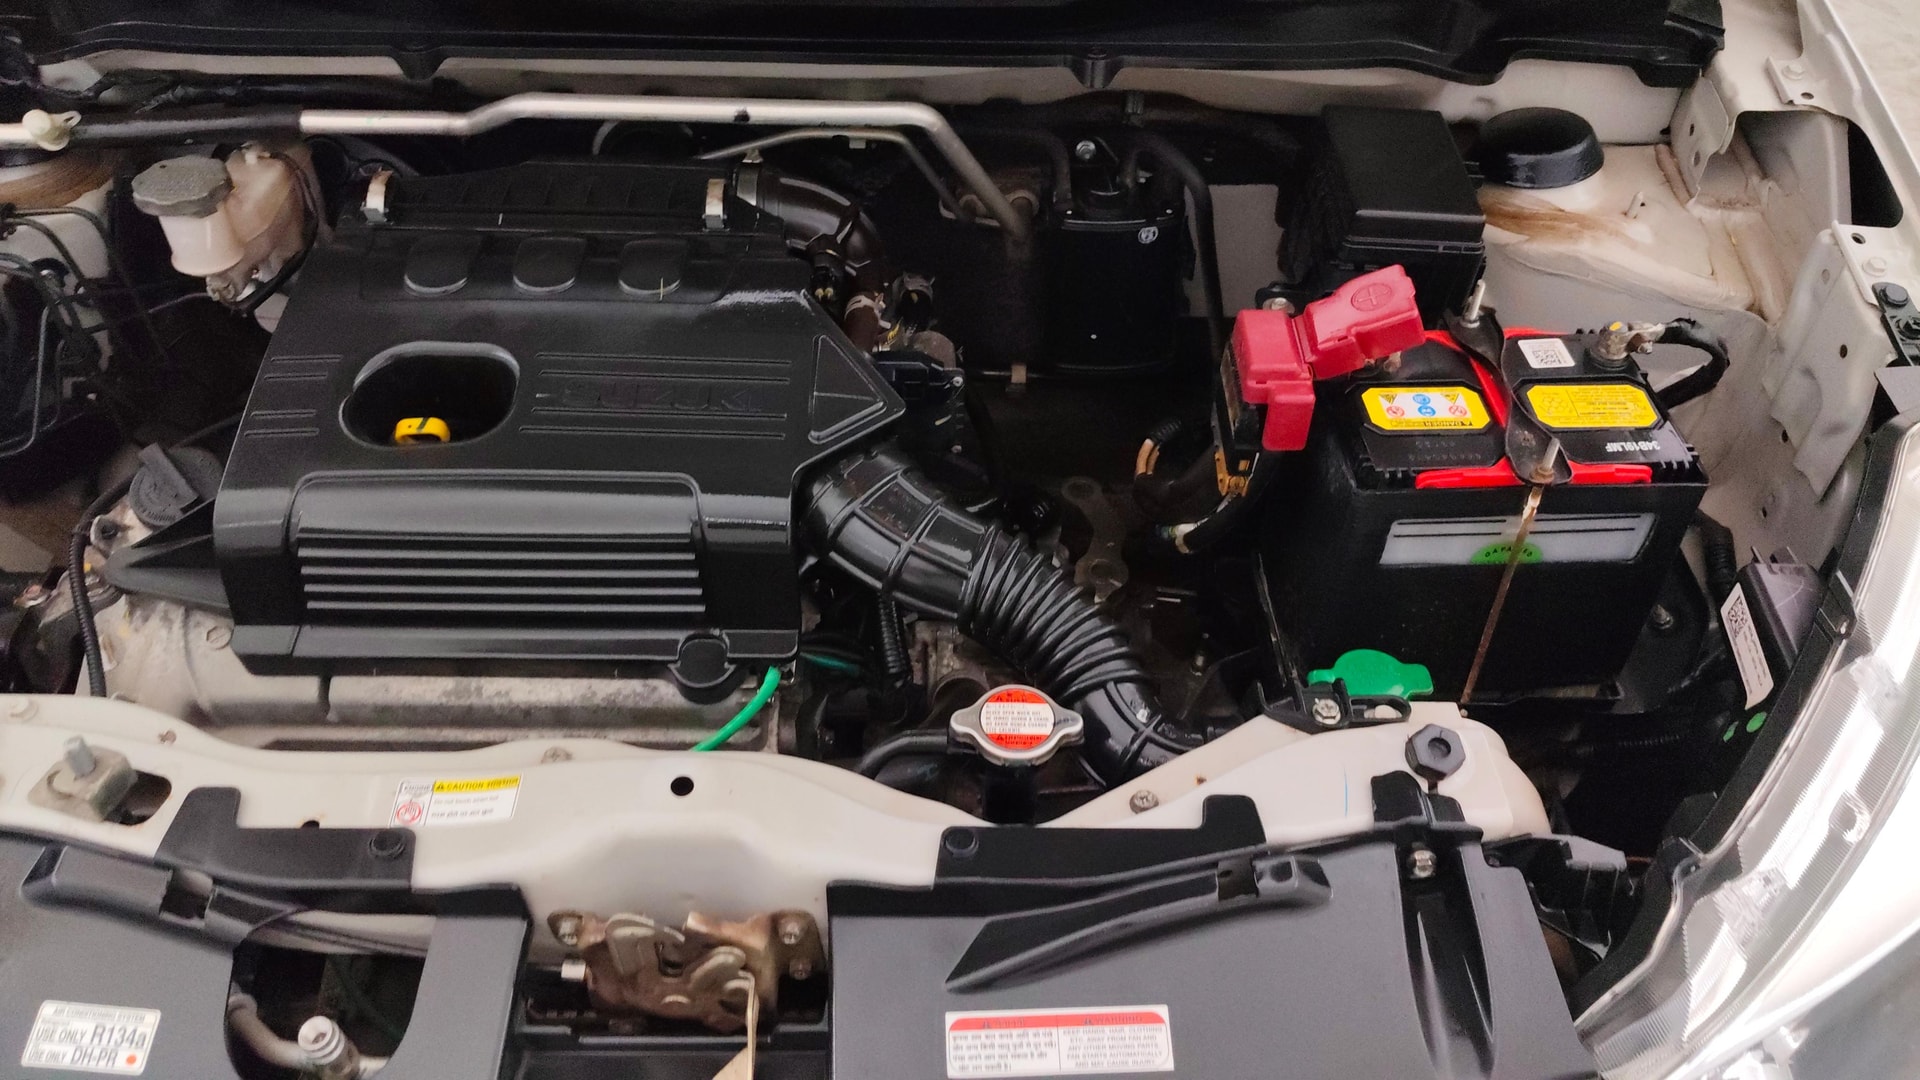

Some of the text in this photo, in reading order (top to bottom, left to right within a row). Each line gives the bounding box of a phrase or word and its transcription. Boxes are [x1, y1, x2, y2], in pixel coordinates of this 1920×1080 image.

[1605, 440, 1661, 453] 34B19LMF
[446, 781, 484, 793] CAUTION
[1096, 1015, 1143, 1024] WARNING
[35, 1022, 147, 1050] USE ONLY R134a
[28, 1048, 44, 1062] USE
[45, 1049, 67, 1064] ONLY
[1109, 1050, 1163, 1058] AUTOMATICALLY
